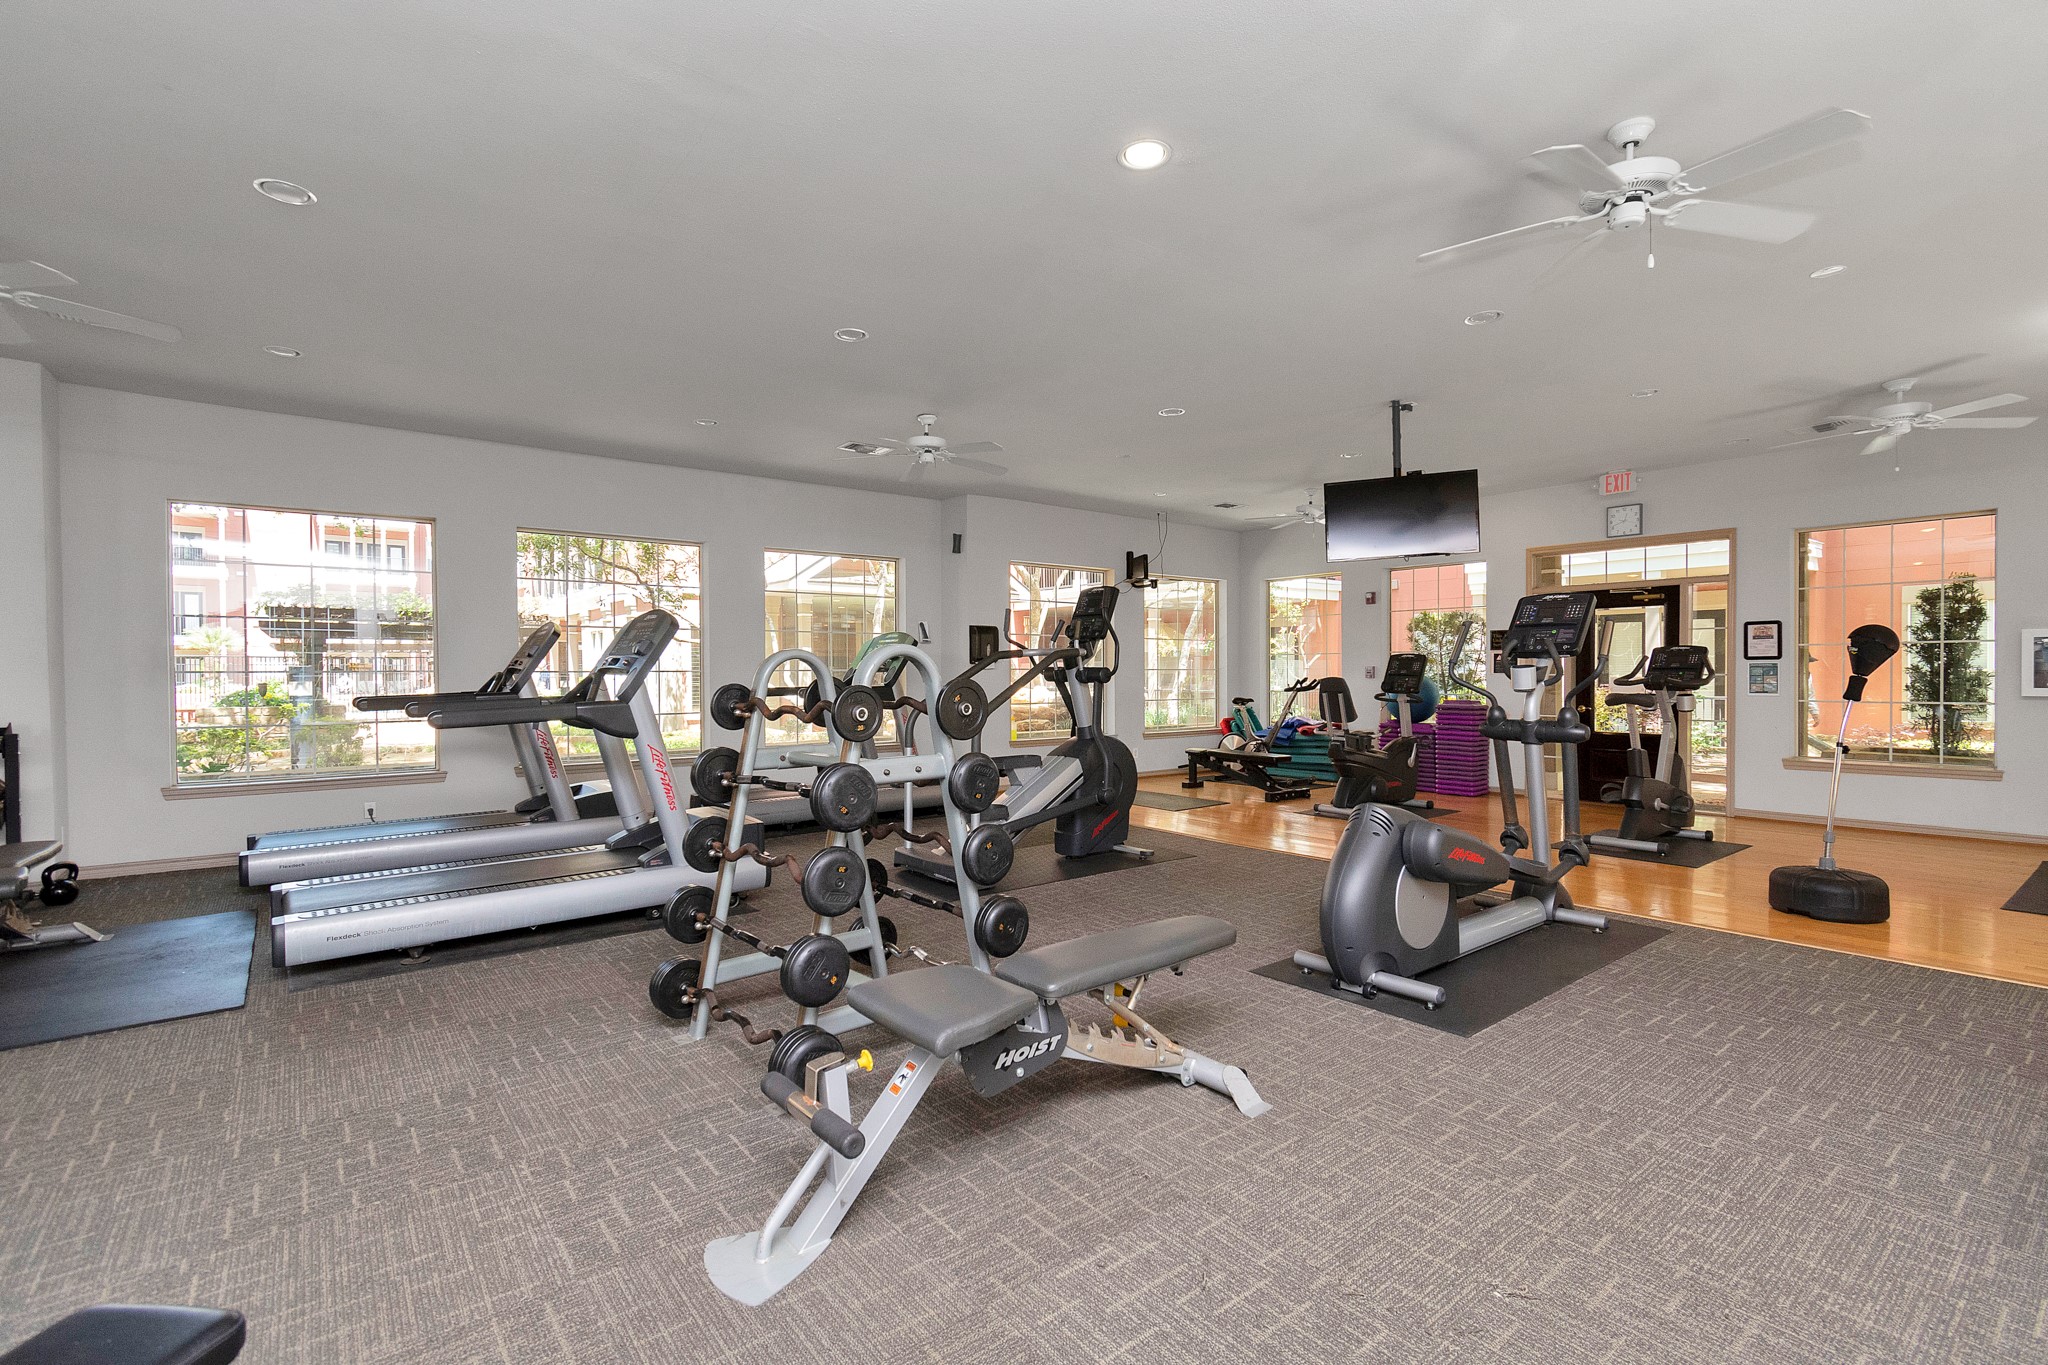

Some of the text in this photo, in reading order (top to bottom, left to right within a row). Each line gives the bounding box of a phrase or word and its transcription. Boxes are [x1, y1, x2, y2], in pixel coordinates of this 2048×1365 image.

[1605, 472, 1632, 493] EXIT
[278, 862, 305, 870] Flexdeck
[326, 932, 361, 942] Flexdeck
[387, 922, 423, 933] Absorption
[424, 919, 450, 929] System
[994, 1034, 1062, 1070] HOIST
